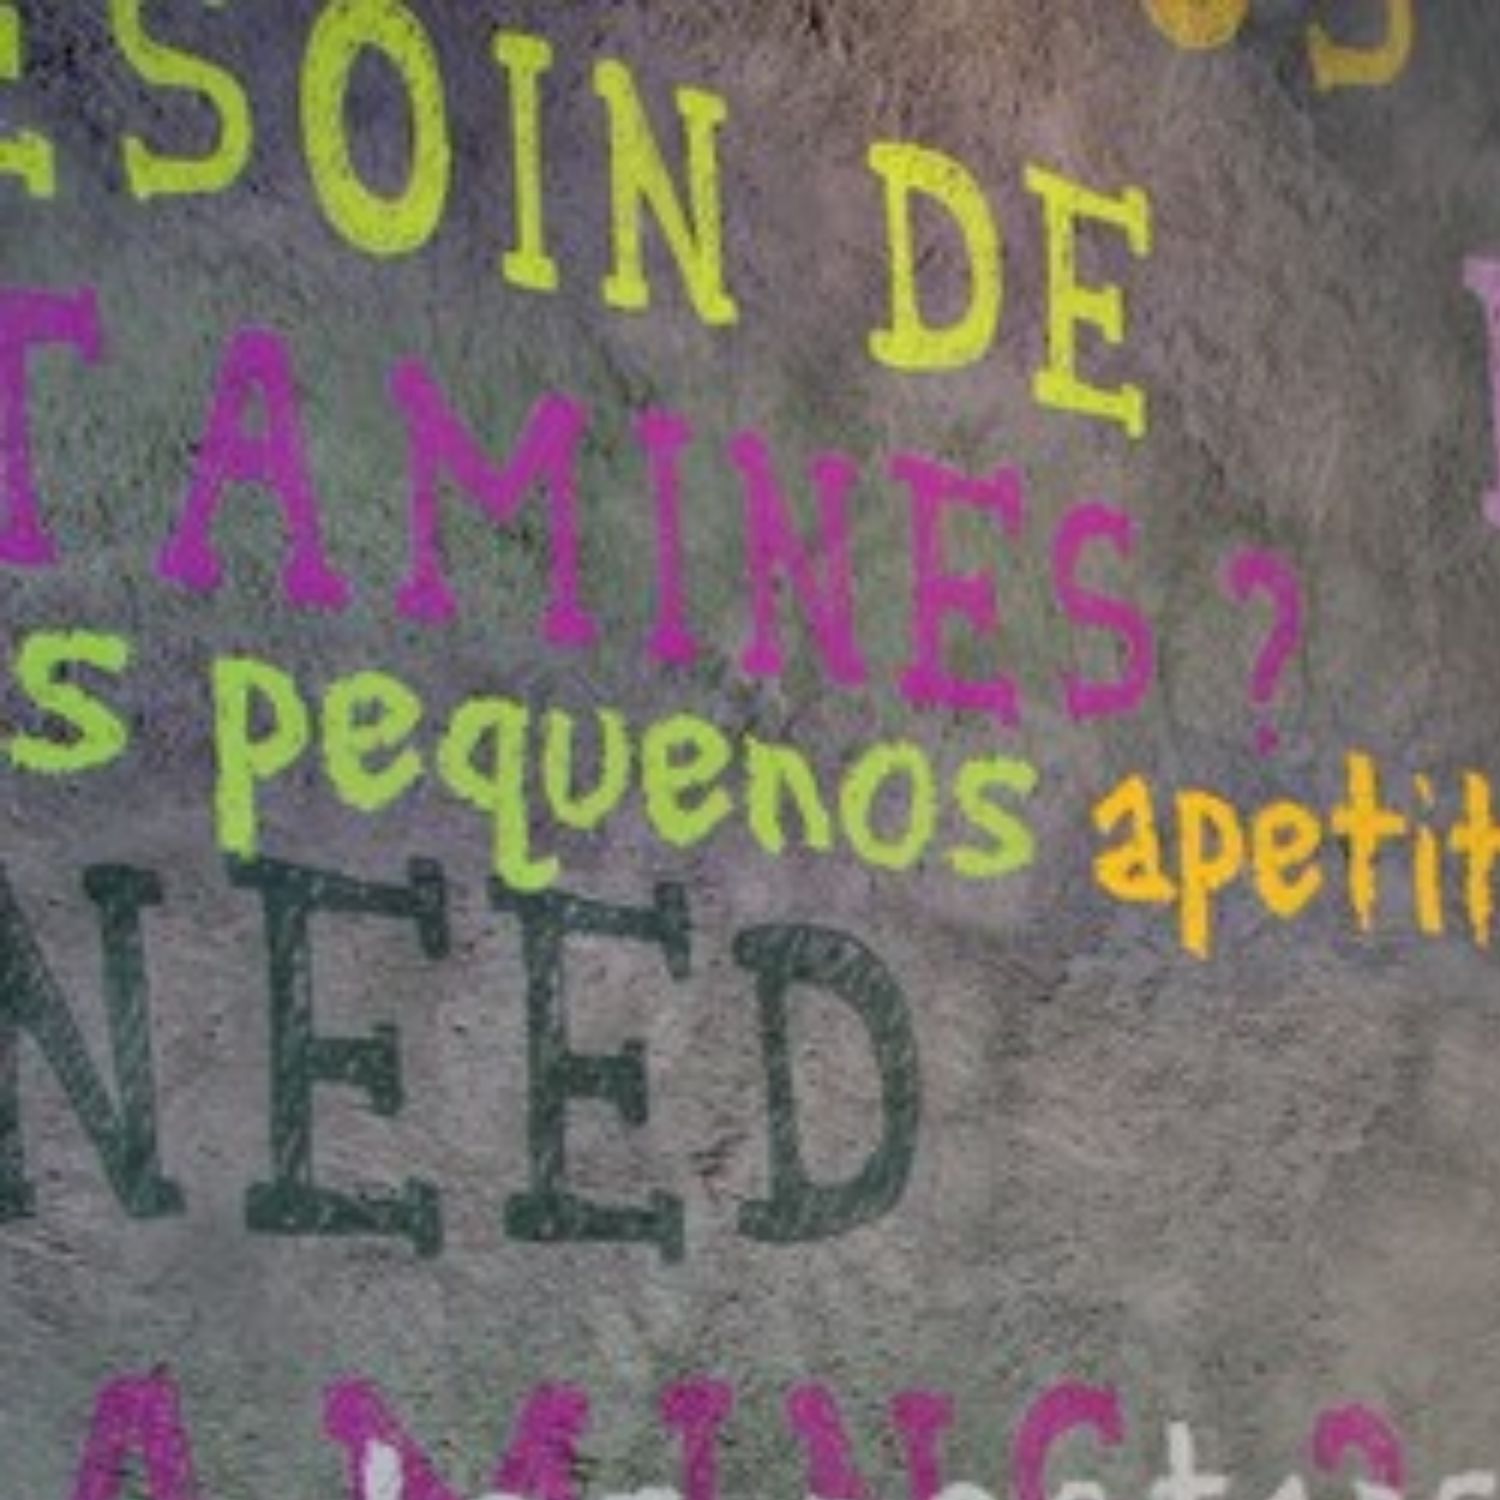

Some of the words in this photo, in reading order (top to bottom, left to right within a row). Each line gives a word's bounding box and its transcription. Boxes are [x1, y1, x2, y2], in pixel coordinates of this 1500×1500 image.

[868, 140, 1152, 440] DE
[212, 654, 1040, 892] pequenos
[1224, 546, 1304, 758] ?
[0, 852, 922, 1264] NEED
